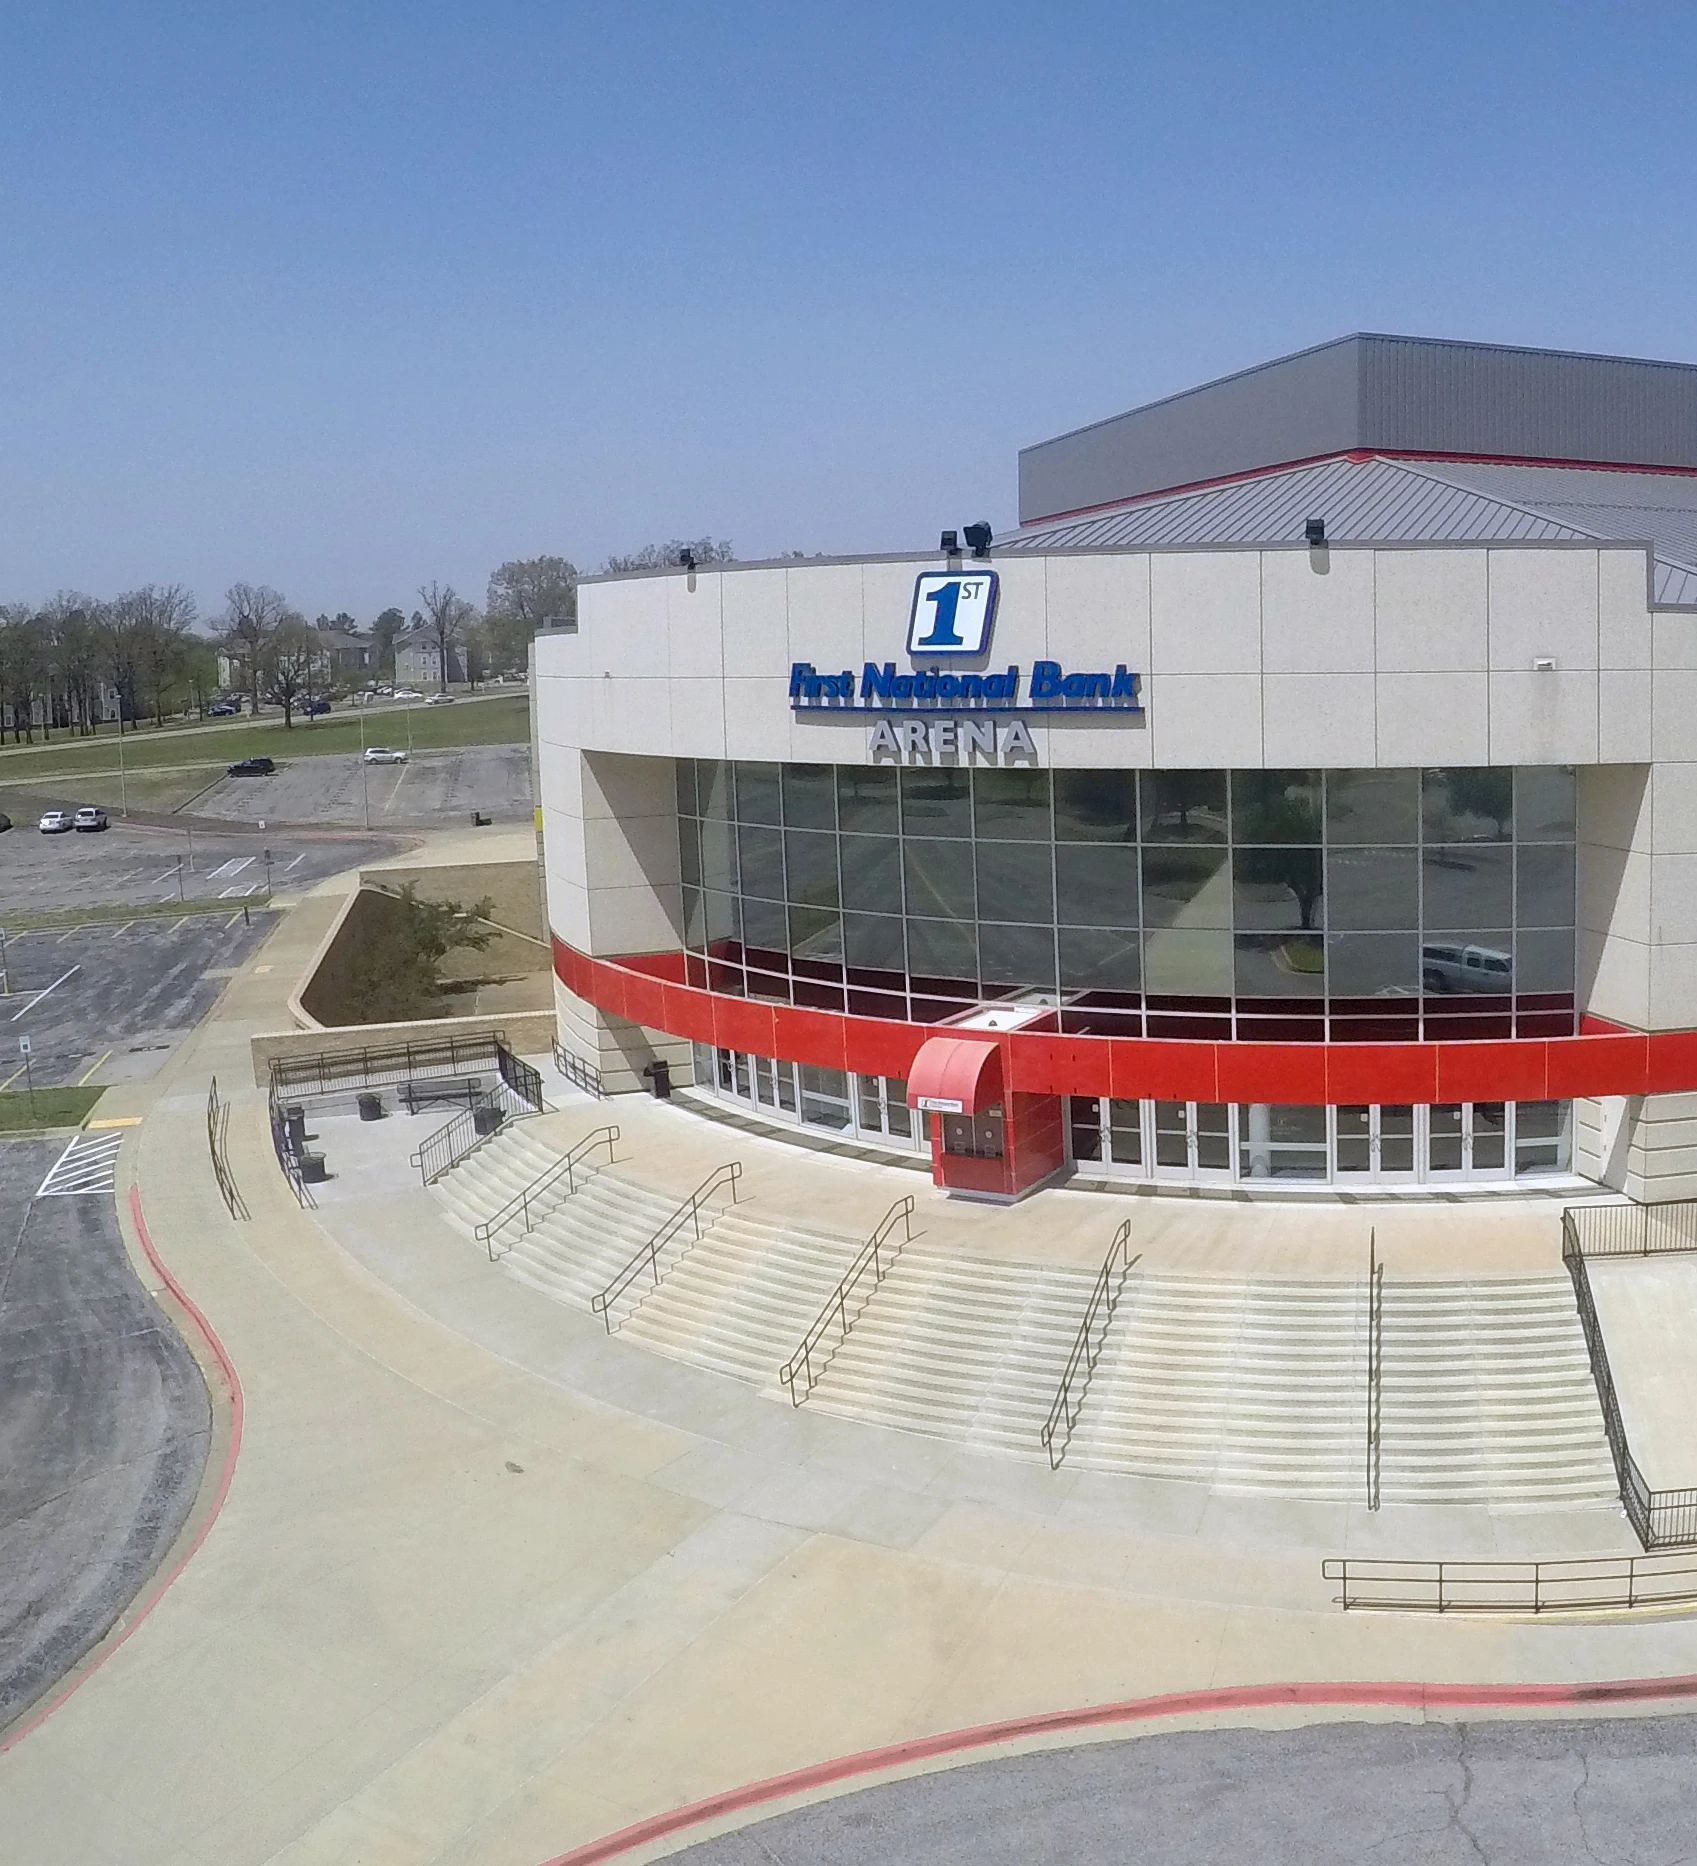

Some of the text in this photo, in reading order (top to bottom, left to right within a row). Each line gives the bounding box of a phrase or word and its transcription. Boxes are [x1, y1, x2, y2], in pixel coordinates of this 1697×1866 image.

[917, 580, 984, 647] 1ST
[788, 660, 1140, 699] First National Bank
[869, 719, 1037, 753] ARENA
